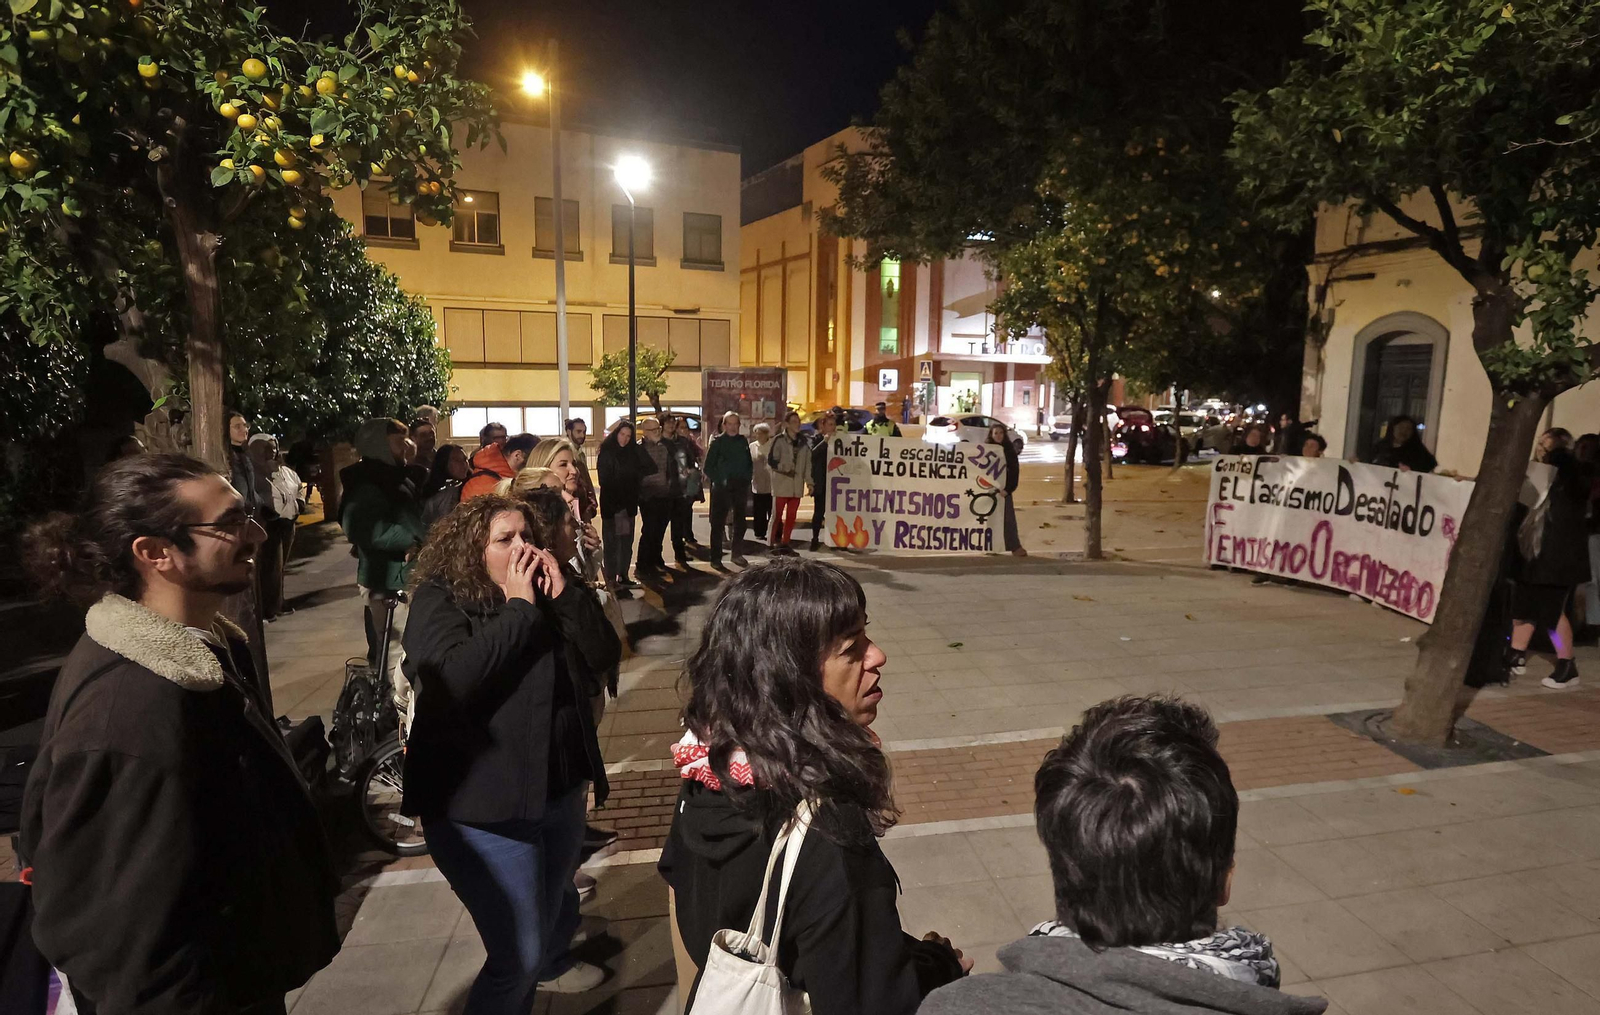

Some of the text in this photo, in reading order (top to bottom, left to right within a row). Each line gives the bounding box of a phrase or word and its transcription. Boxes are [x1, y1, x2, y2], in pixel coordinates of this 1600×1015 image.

[968, 341, 1045, 356] TEATRO
[709, 379, 780, 389] TEATRO FLORIDA
[834, 436, 965, 464] Ante la escalada
[967, 444, 1007, 481] 25N
[870, 460, 968, 479] VIOLENCIA
[830, 477, 960, 519] FEMINISMOS
[1218, 476, 1245, 501] EL
[1333, 464, 1435, 537] Desatado
[872, 519, 993, 551] Y RESISTENCIA
